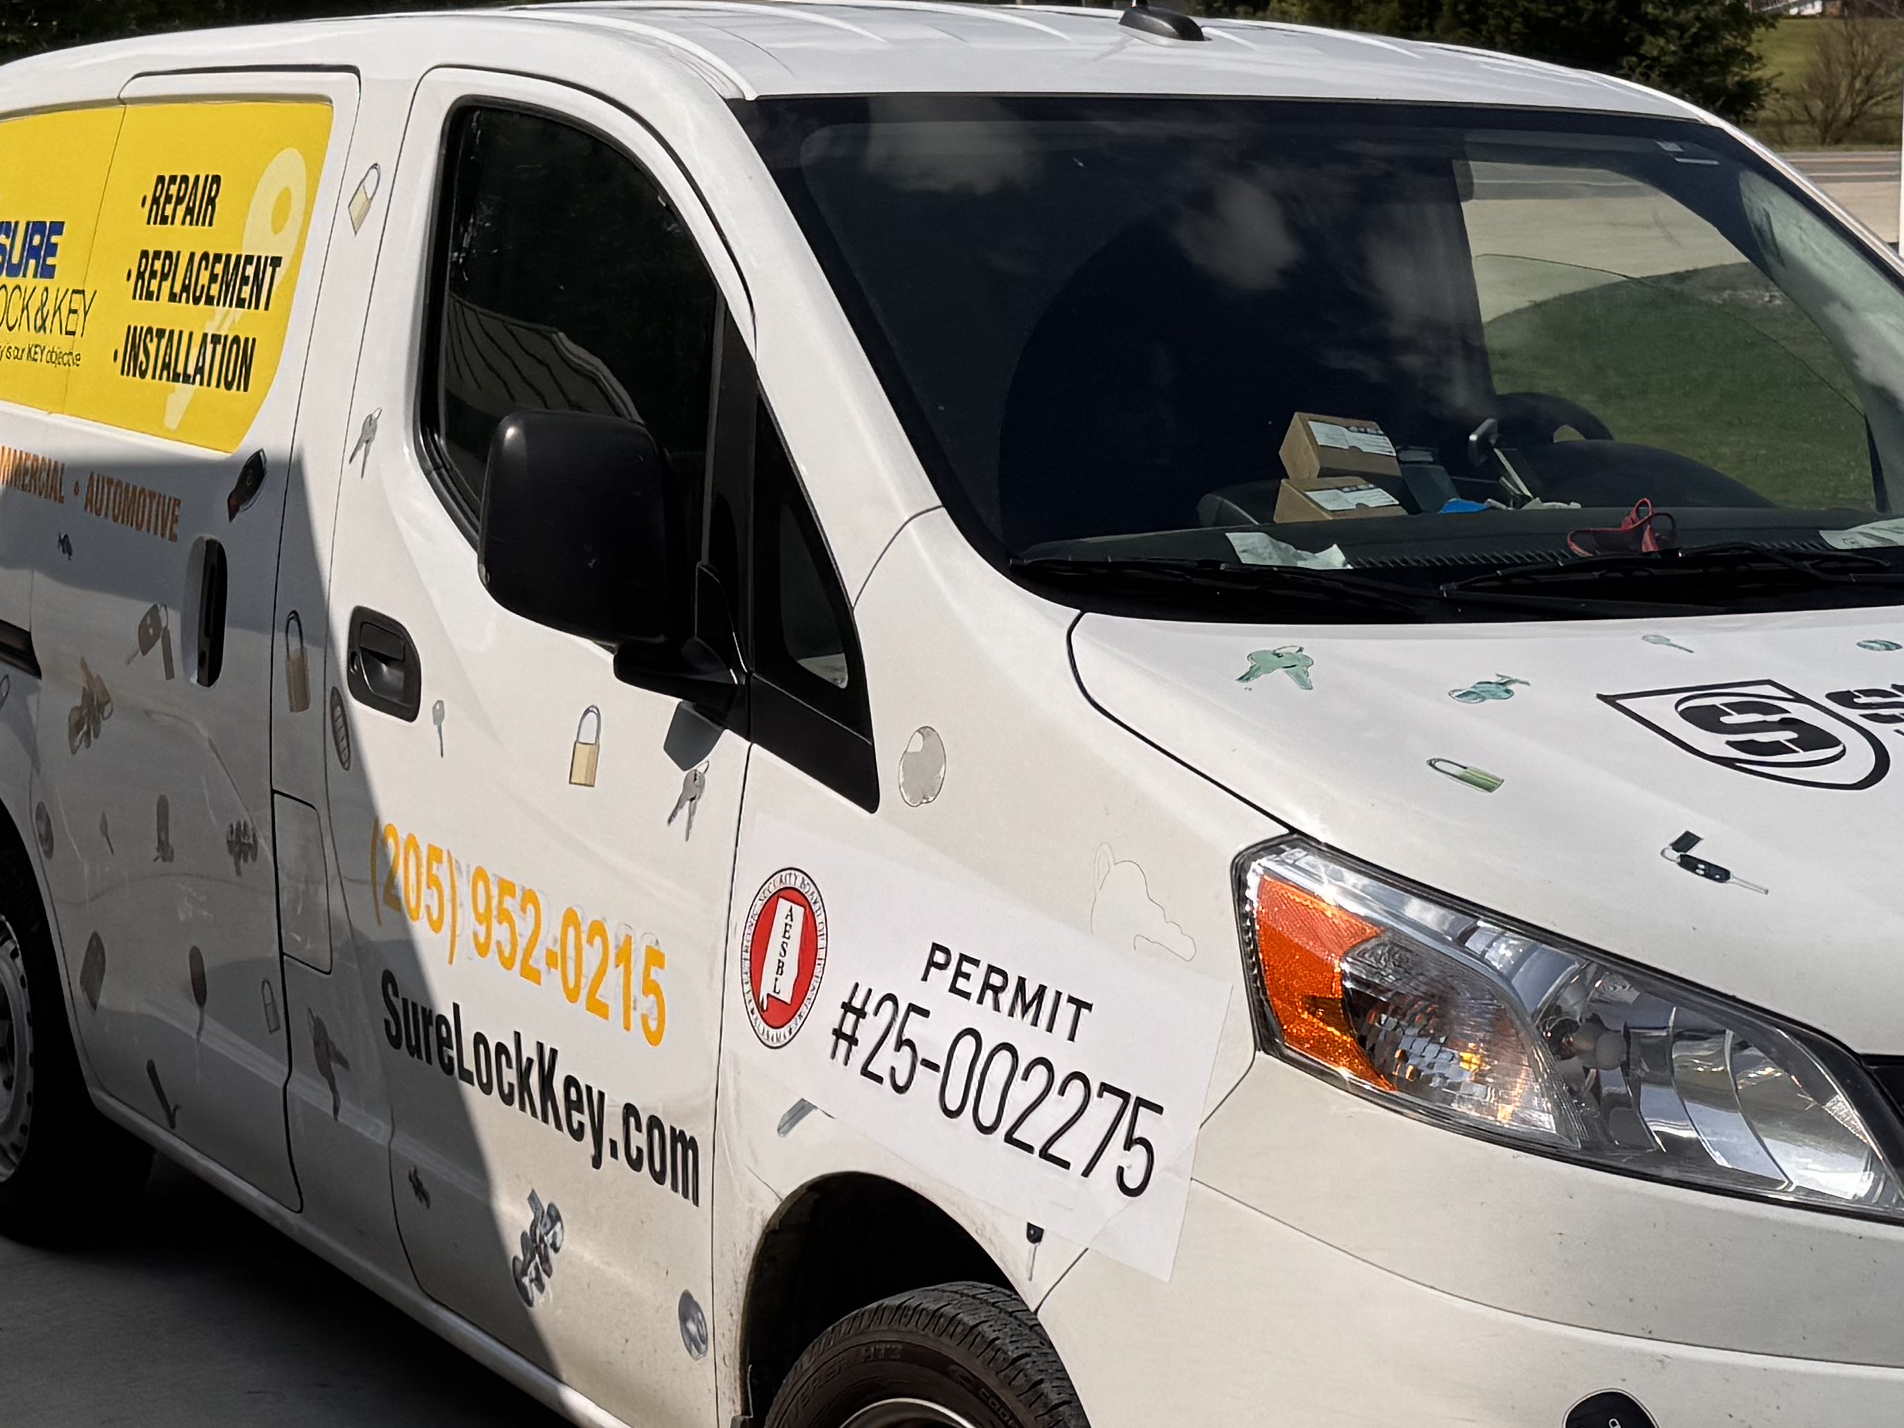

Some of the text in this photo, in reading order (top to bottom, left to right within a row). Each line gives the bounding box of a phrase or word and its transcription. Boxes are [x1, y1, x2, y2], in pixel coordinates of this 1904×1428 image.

[146, 174, 222, 227] REPAIR
[132, 249, 282, 311] REPLACEMENT
[26, 343, 46, 364] KEY
[46, 345, 82, 368] objective
[120, 324, 256, 393] INSTALLATION
[84, 472, 182, 543] AUTOMOTIVE
[371, 818, 459, 964] (205)
[470, 865, 667, 1047] 952-0215
[922, 941, 1094, 1044] PERMIT
[381, 966, 701, 1208] SureLockKey.com
[830, 981, 1165, 1199] #25-002275
